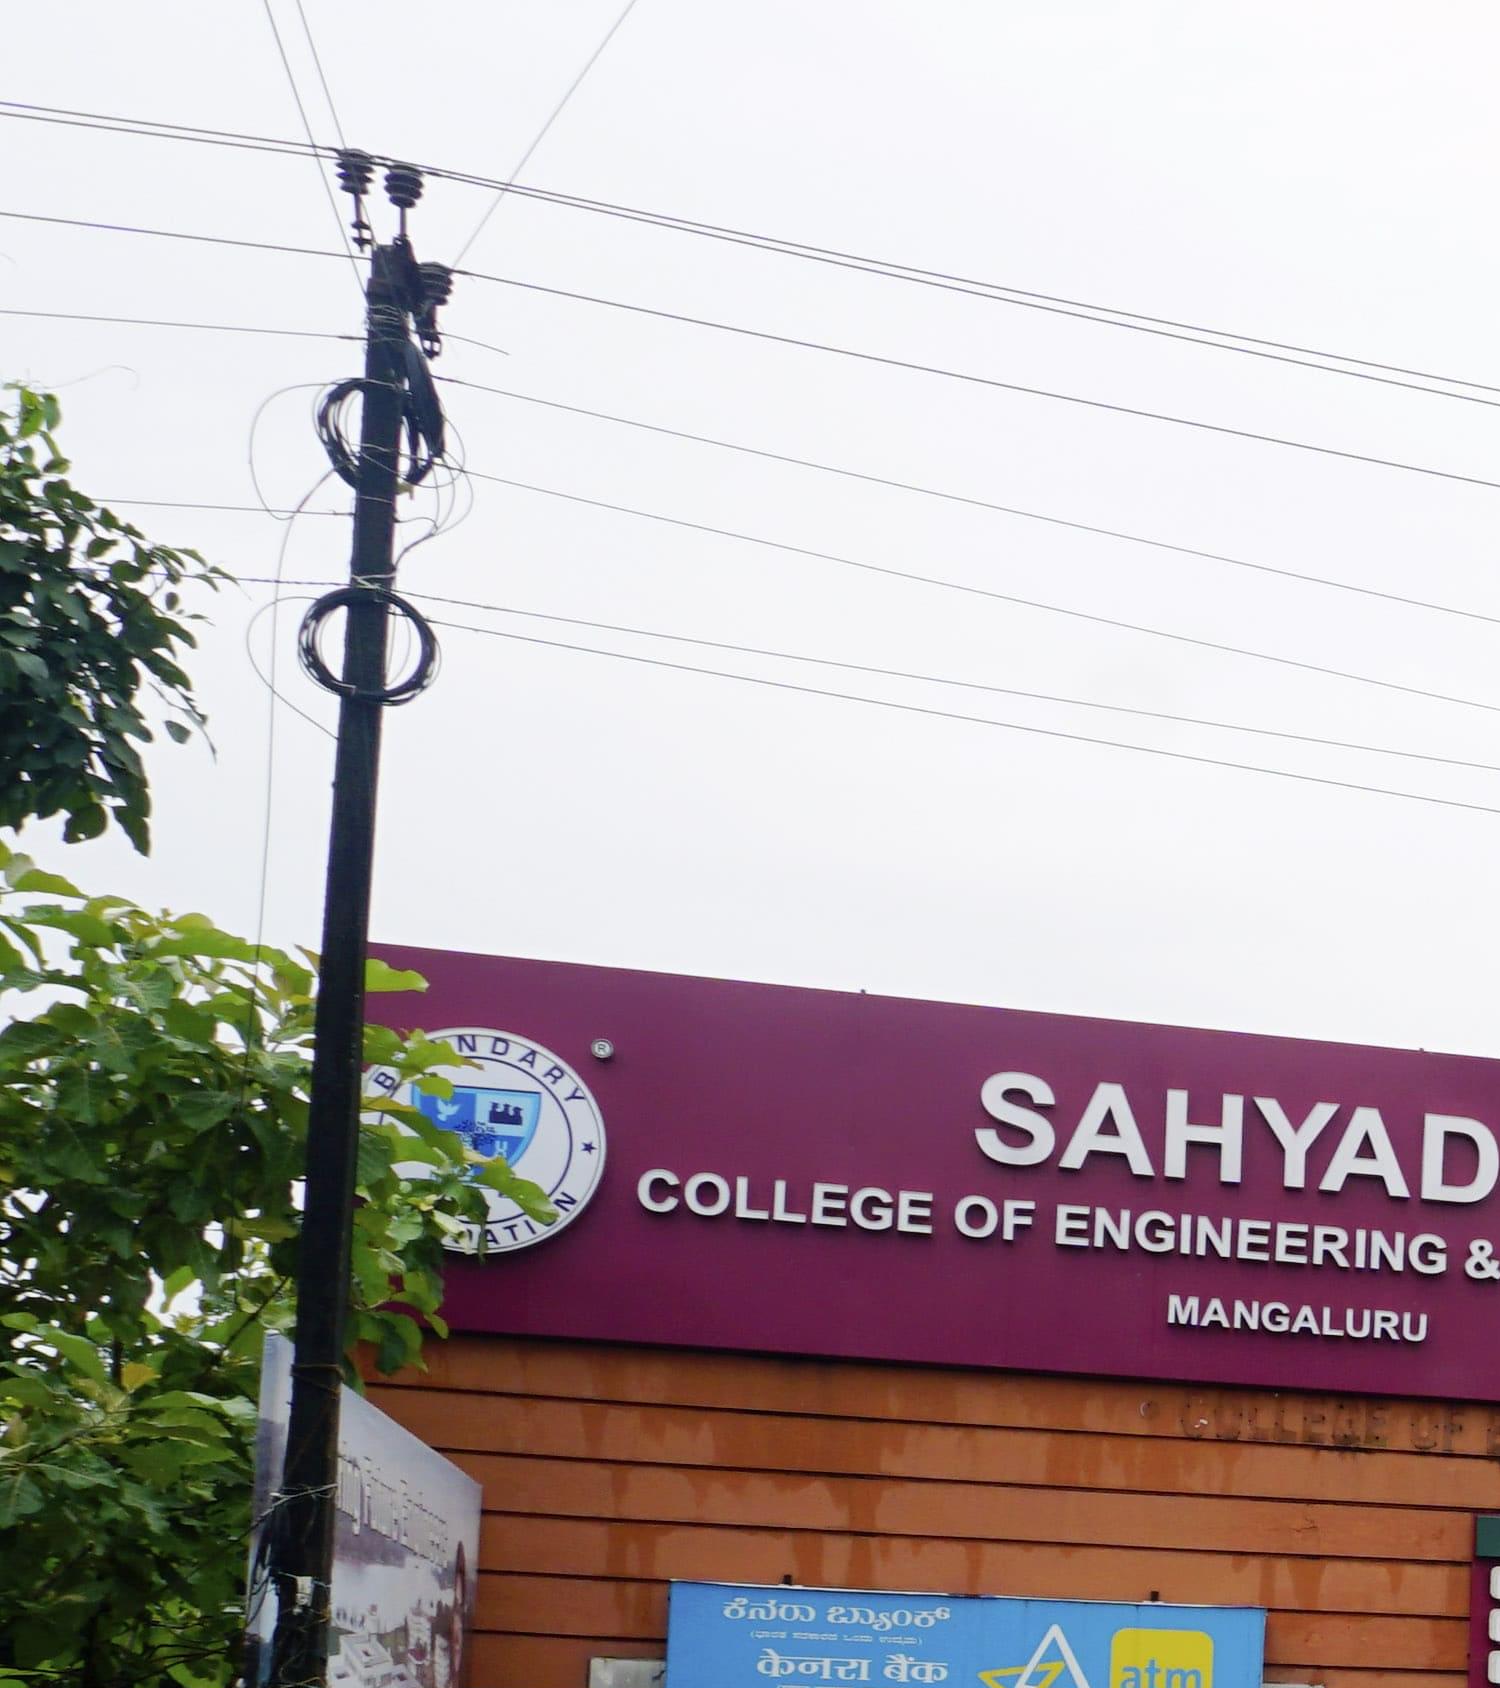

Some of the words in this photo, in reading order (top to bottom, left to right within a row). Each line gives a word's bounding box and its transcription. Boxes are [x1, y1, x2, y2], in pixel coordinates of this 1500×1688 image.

[373, 1034, 586, 1103] BNDARY
[637, 1169, 933, 1235] COLLEGE
[954, 1196, 1034, 1241] OF
[1055, 1205, 1448, 1275] ENGINEERING
[1168, 1295, 1428, 1343] MANGALURU
[756, 1648, 872, 1681] केनरा
[883, 1653, 948, 1683] बैंक
